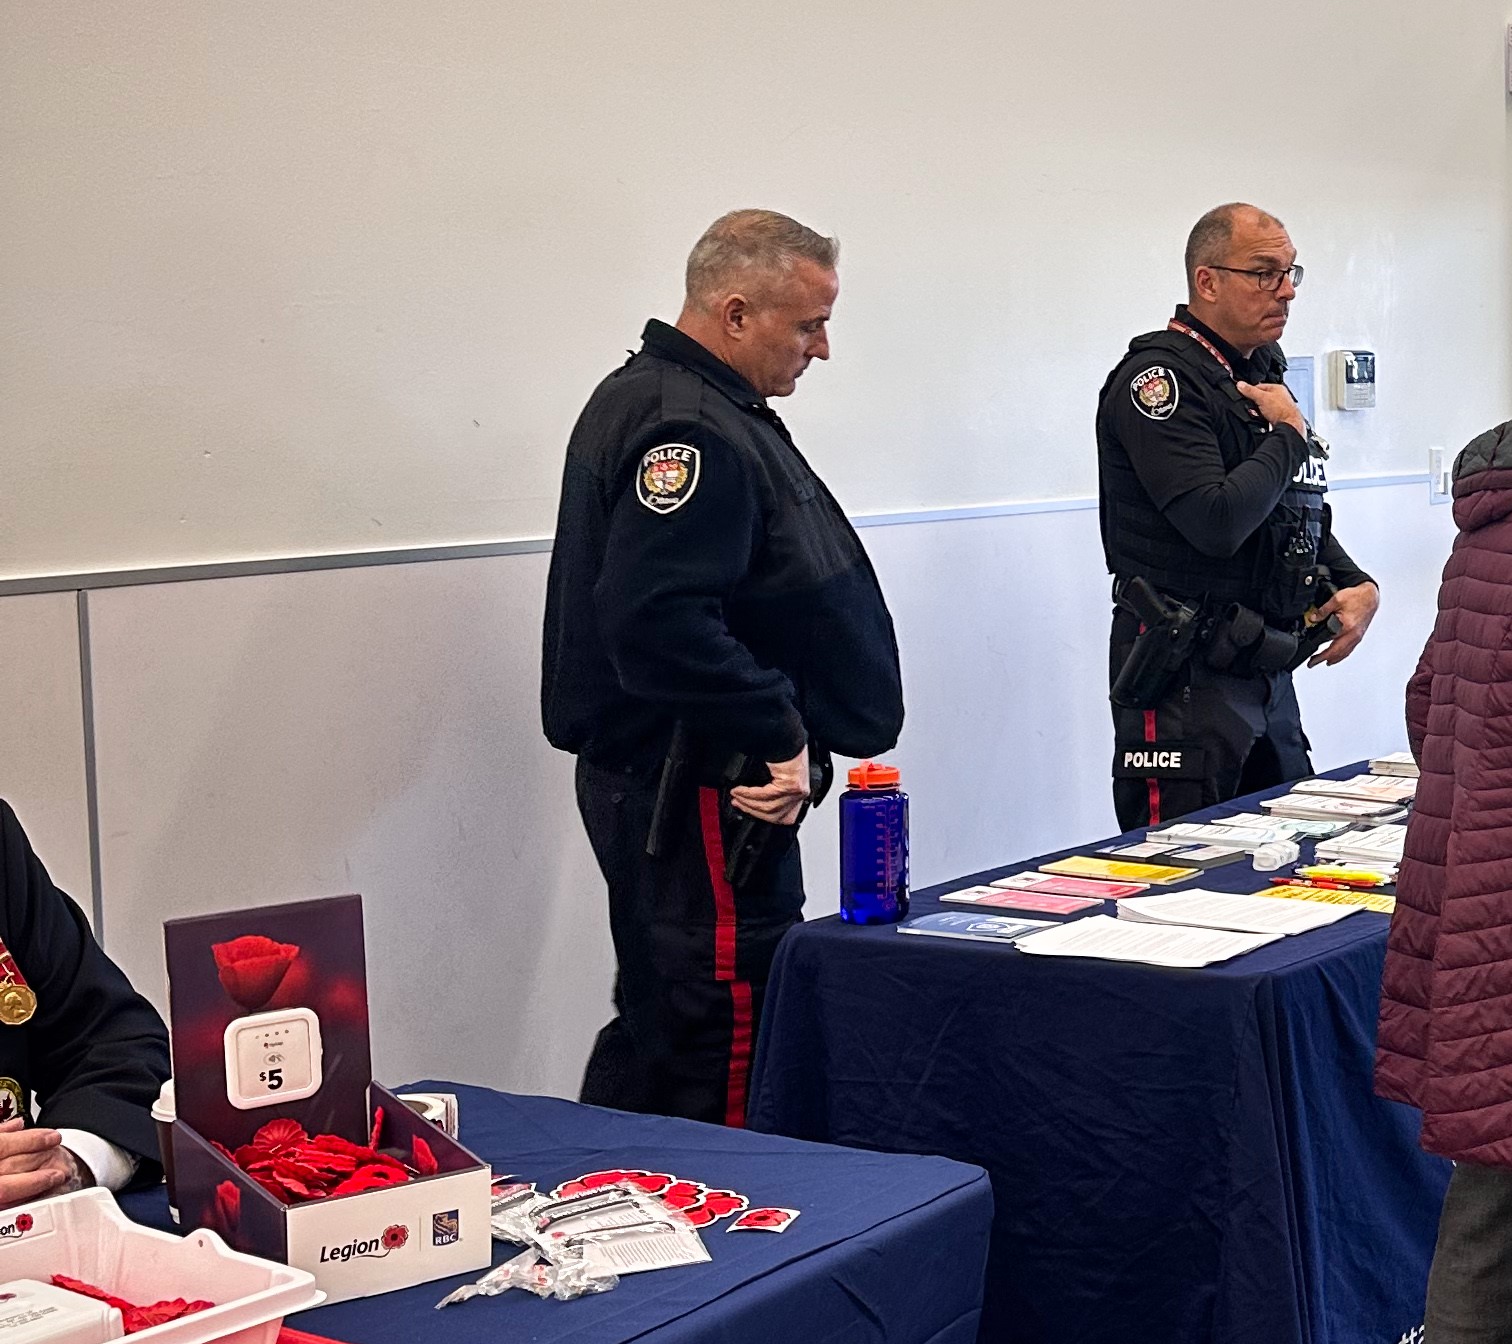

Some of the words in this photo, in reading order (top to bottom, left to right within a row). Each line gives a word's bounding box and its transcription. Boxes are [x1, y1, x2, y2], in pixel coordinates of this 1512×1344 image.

[1132, 367, 1165, 392] POLICE
[643, 448, 693, 468] POLICE
[1292, 455, 1328, 487] LICE
[1124, 751, 1182, 769] POLICE
[259, 1068, 283, 1090] $5
[435, 1233, 457, 1245] RBC
[320, 1238, 379, 1264] Legion
